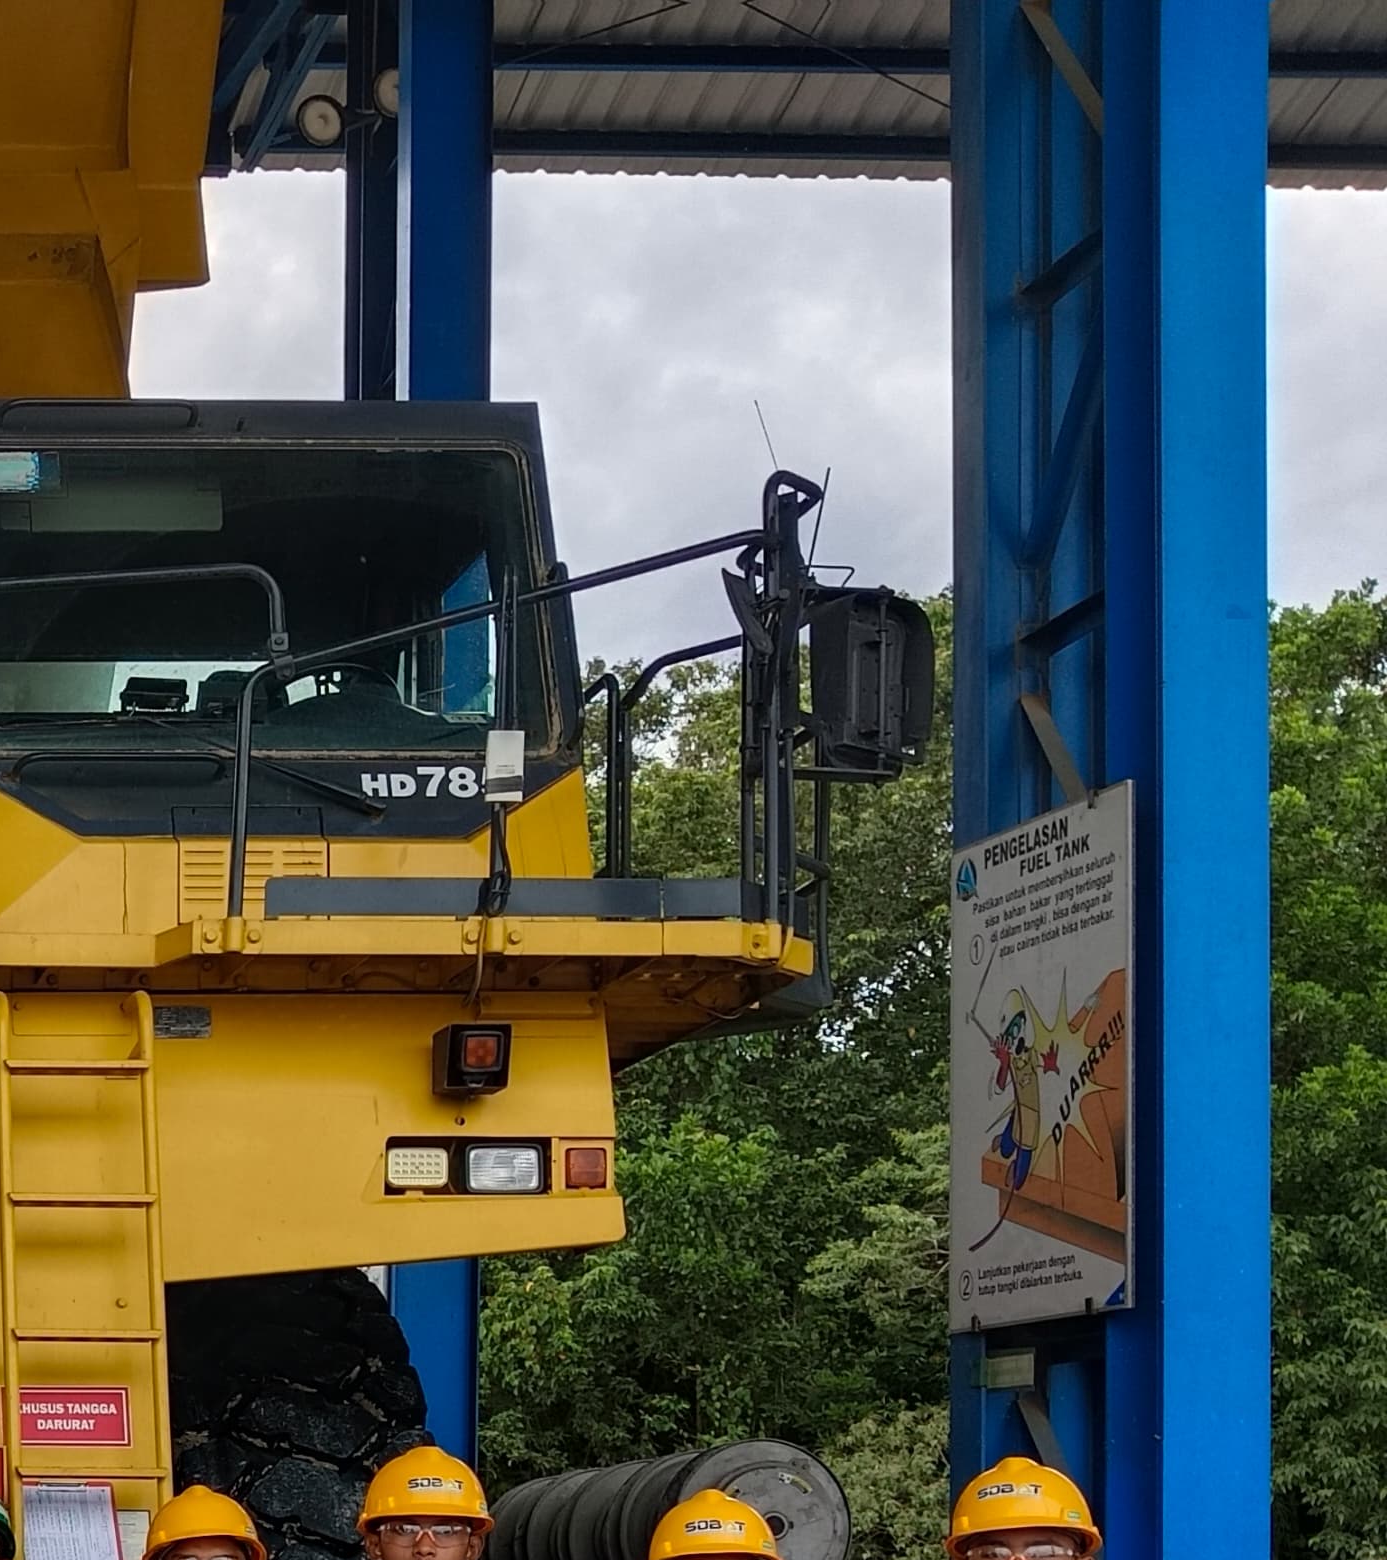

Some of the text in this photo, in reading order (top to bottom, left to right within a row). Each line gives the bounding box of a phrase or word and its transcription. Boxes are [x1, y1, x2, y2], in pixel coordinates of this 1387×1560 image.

[361, 766, 487, 798] HD78
[984, 816, 1069, 870] PENGELASAN
[1019, 834, 1091, 877] FUEL TANK
[972, 895, 1004, 915] Pastikan
[1005, 886, 1026, 904] untuk
[984, 914, 1000, 929] sisa
[1029, 895, 1052, 911] bakar
[1054, 889, 1074, 906] yang
[1052, 909, 1069, 922] bisa
[1070, 898, 1100, 917] dengan
[1101, 891, 1113, 905] air
[1061, 920, 1078, 936] bisa
[1050, 1254, 1076, 1272] dengan
[36, 1418, 96, 1430] DARURAT
[67, 1403, 118, 1415] TANGGA
